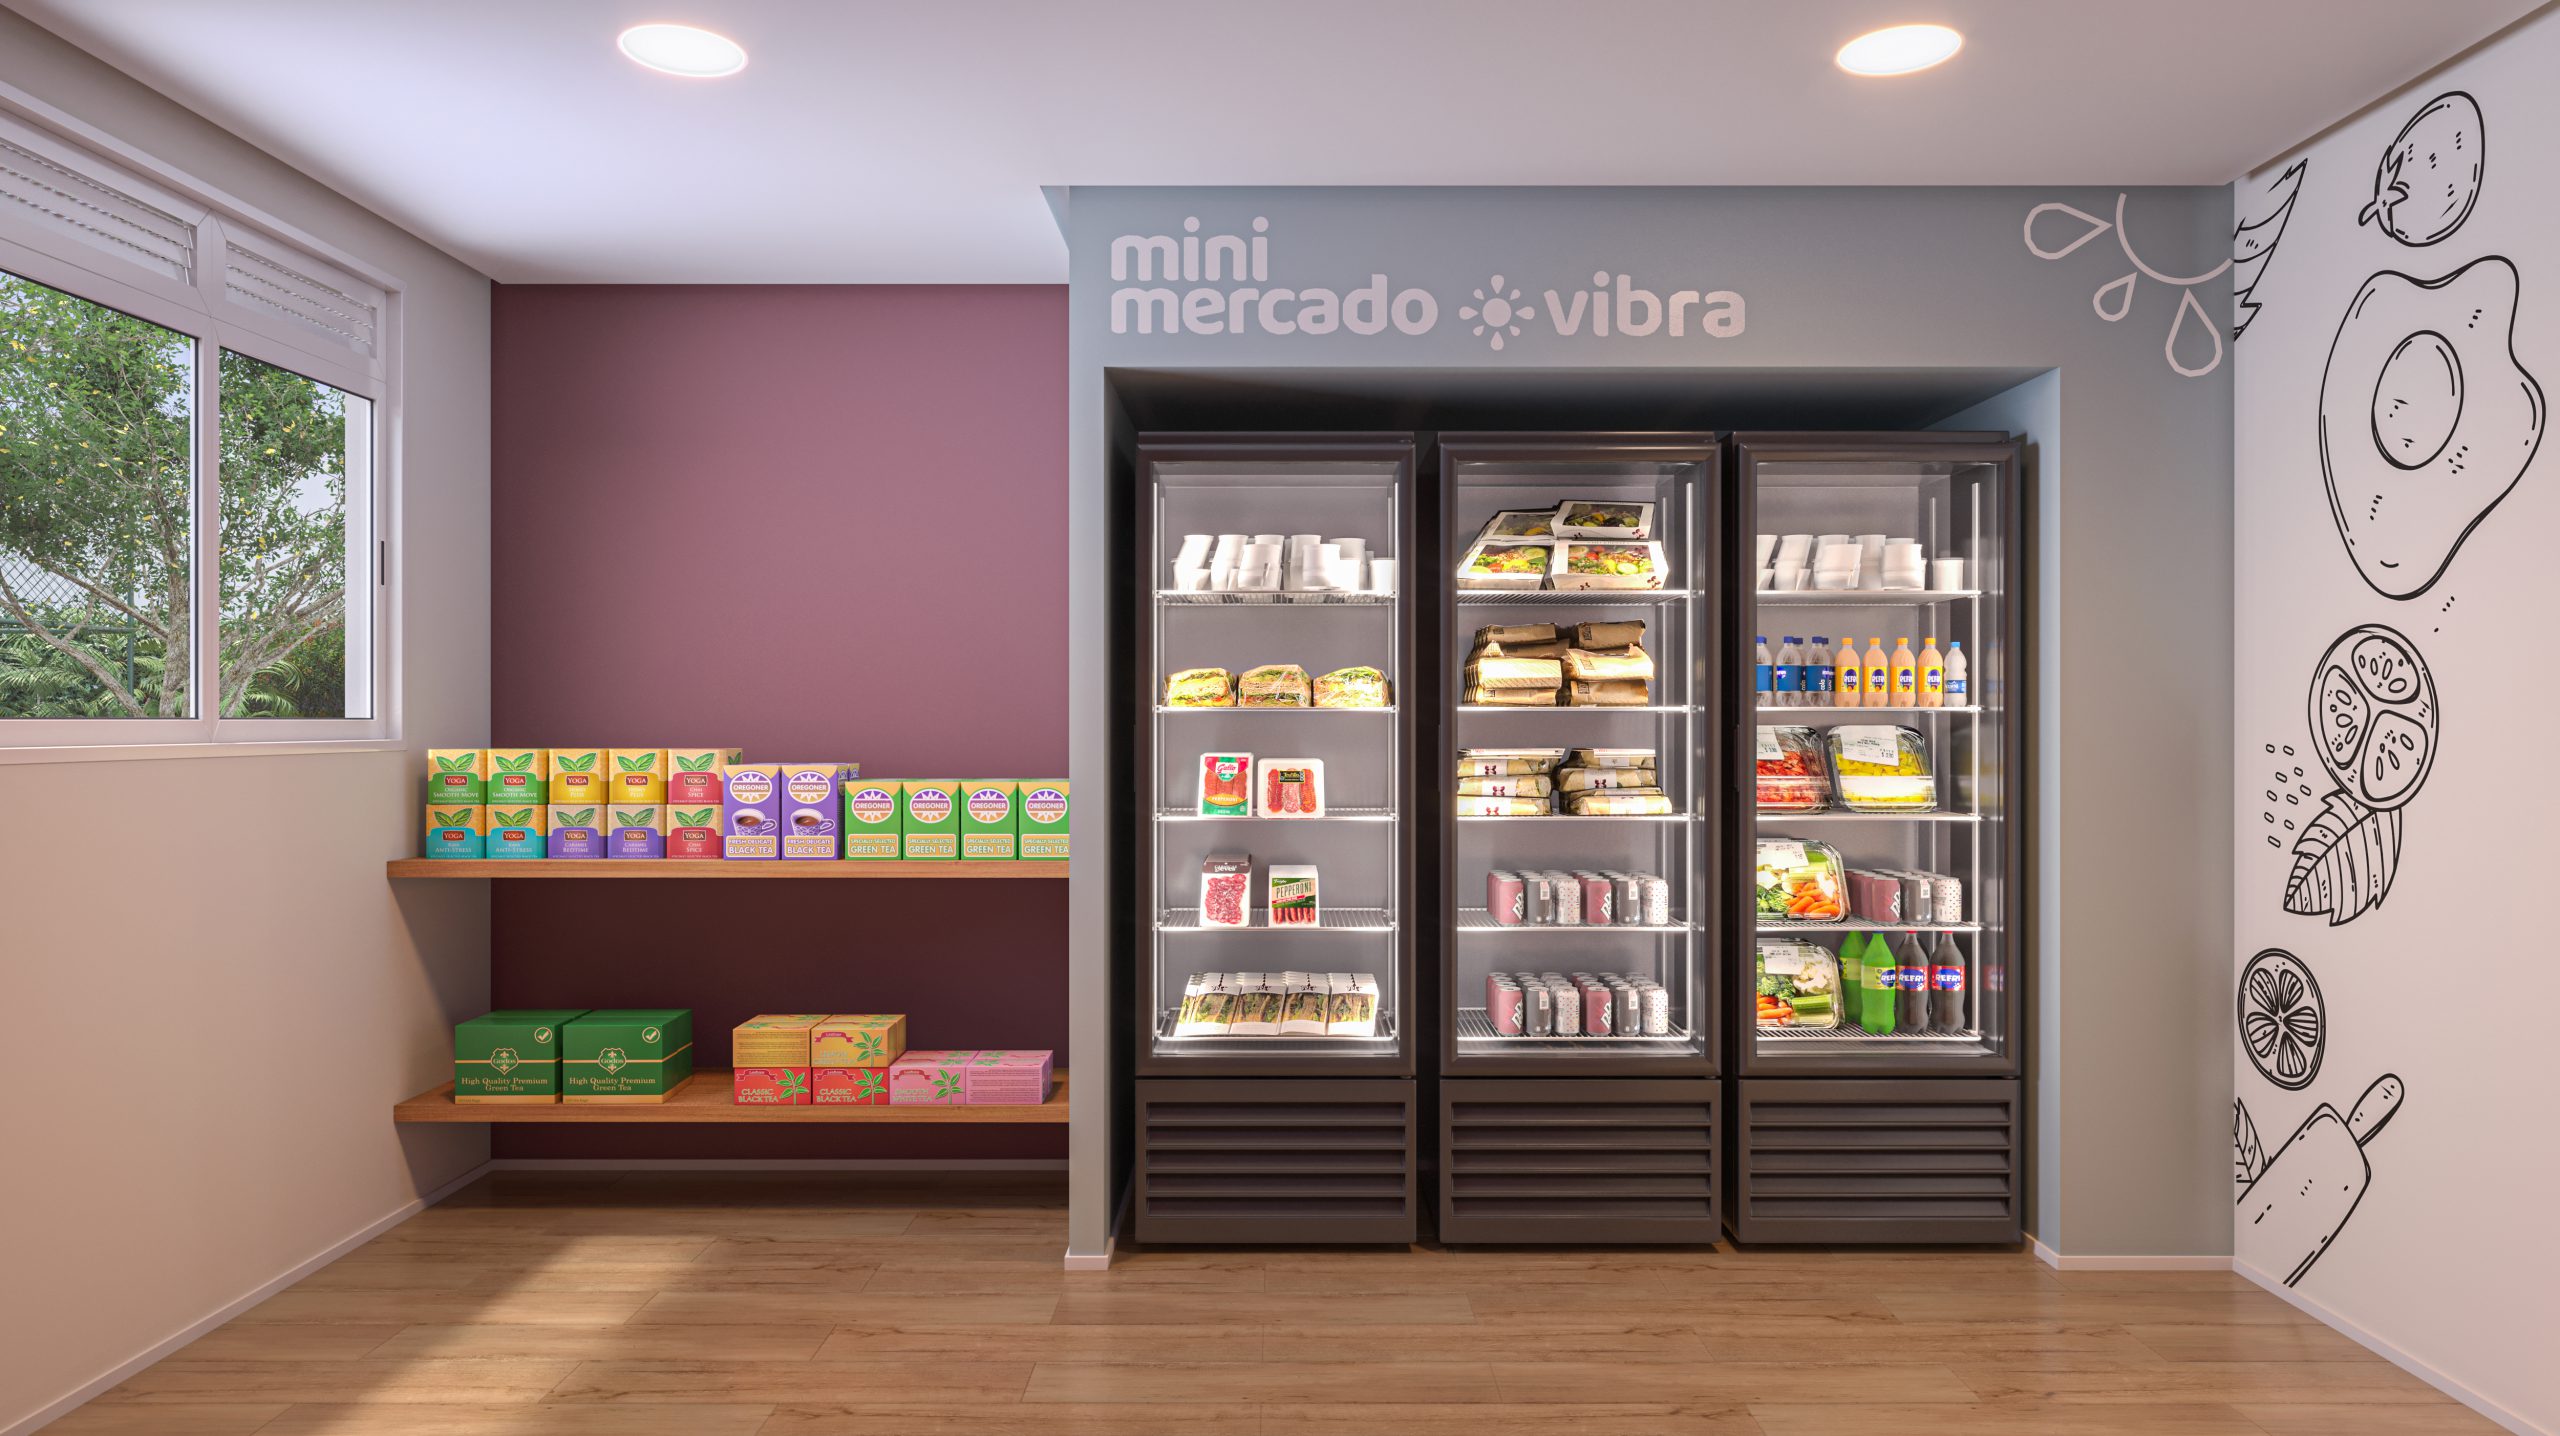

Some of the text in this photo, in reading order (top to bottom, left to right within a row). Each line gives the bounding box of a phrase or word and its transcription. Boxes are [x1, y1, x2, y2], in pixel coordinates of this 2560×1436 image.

[1111, 216, 1268, 282] mini
[1111, 270, 1746, 338] mercado vibra
[446, 776, 466, 784] YOGA
[505, 776, 525, 784] YOGA
[568, 776, 587, 784] YOGA
[627, 776, 646, 784] YOGA
[686, 776, 706, 784] YOGA
[444, 832, 463, 840] YOGA
[504, 832, 524, 840] YOGA
[565, 832, 586, 840] YOGA
[625, 832, 646, 840] YOGA
[684, 832, 705, 840] YOGA
[729, 846, 773, 854] BLACK TEA
[787, 846, 832, 854] BLACK TEA
[850, 846, 896, 854] GREEN TEA
[908, 846, 954, 854] GREEN TEA
[966, 846, 1011, 854] GREEN TEA
[1024, 846, 1069, 854] GREEN TEA
[1276, 881, 1312, 898] PEPPERONI
[461, 1077, 548, 1086] High Quality Premium
[569, 1077, 656, 1086] High Quality Premium
[741, 1088, 774, 1096] CLASSIC
[819, 1088, 852, 1096] CLASSIC
[738, 1095, 779, 1103] BLACK TEA
[816, 1095, 857, 1103] BLACK TEA
